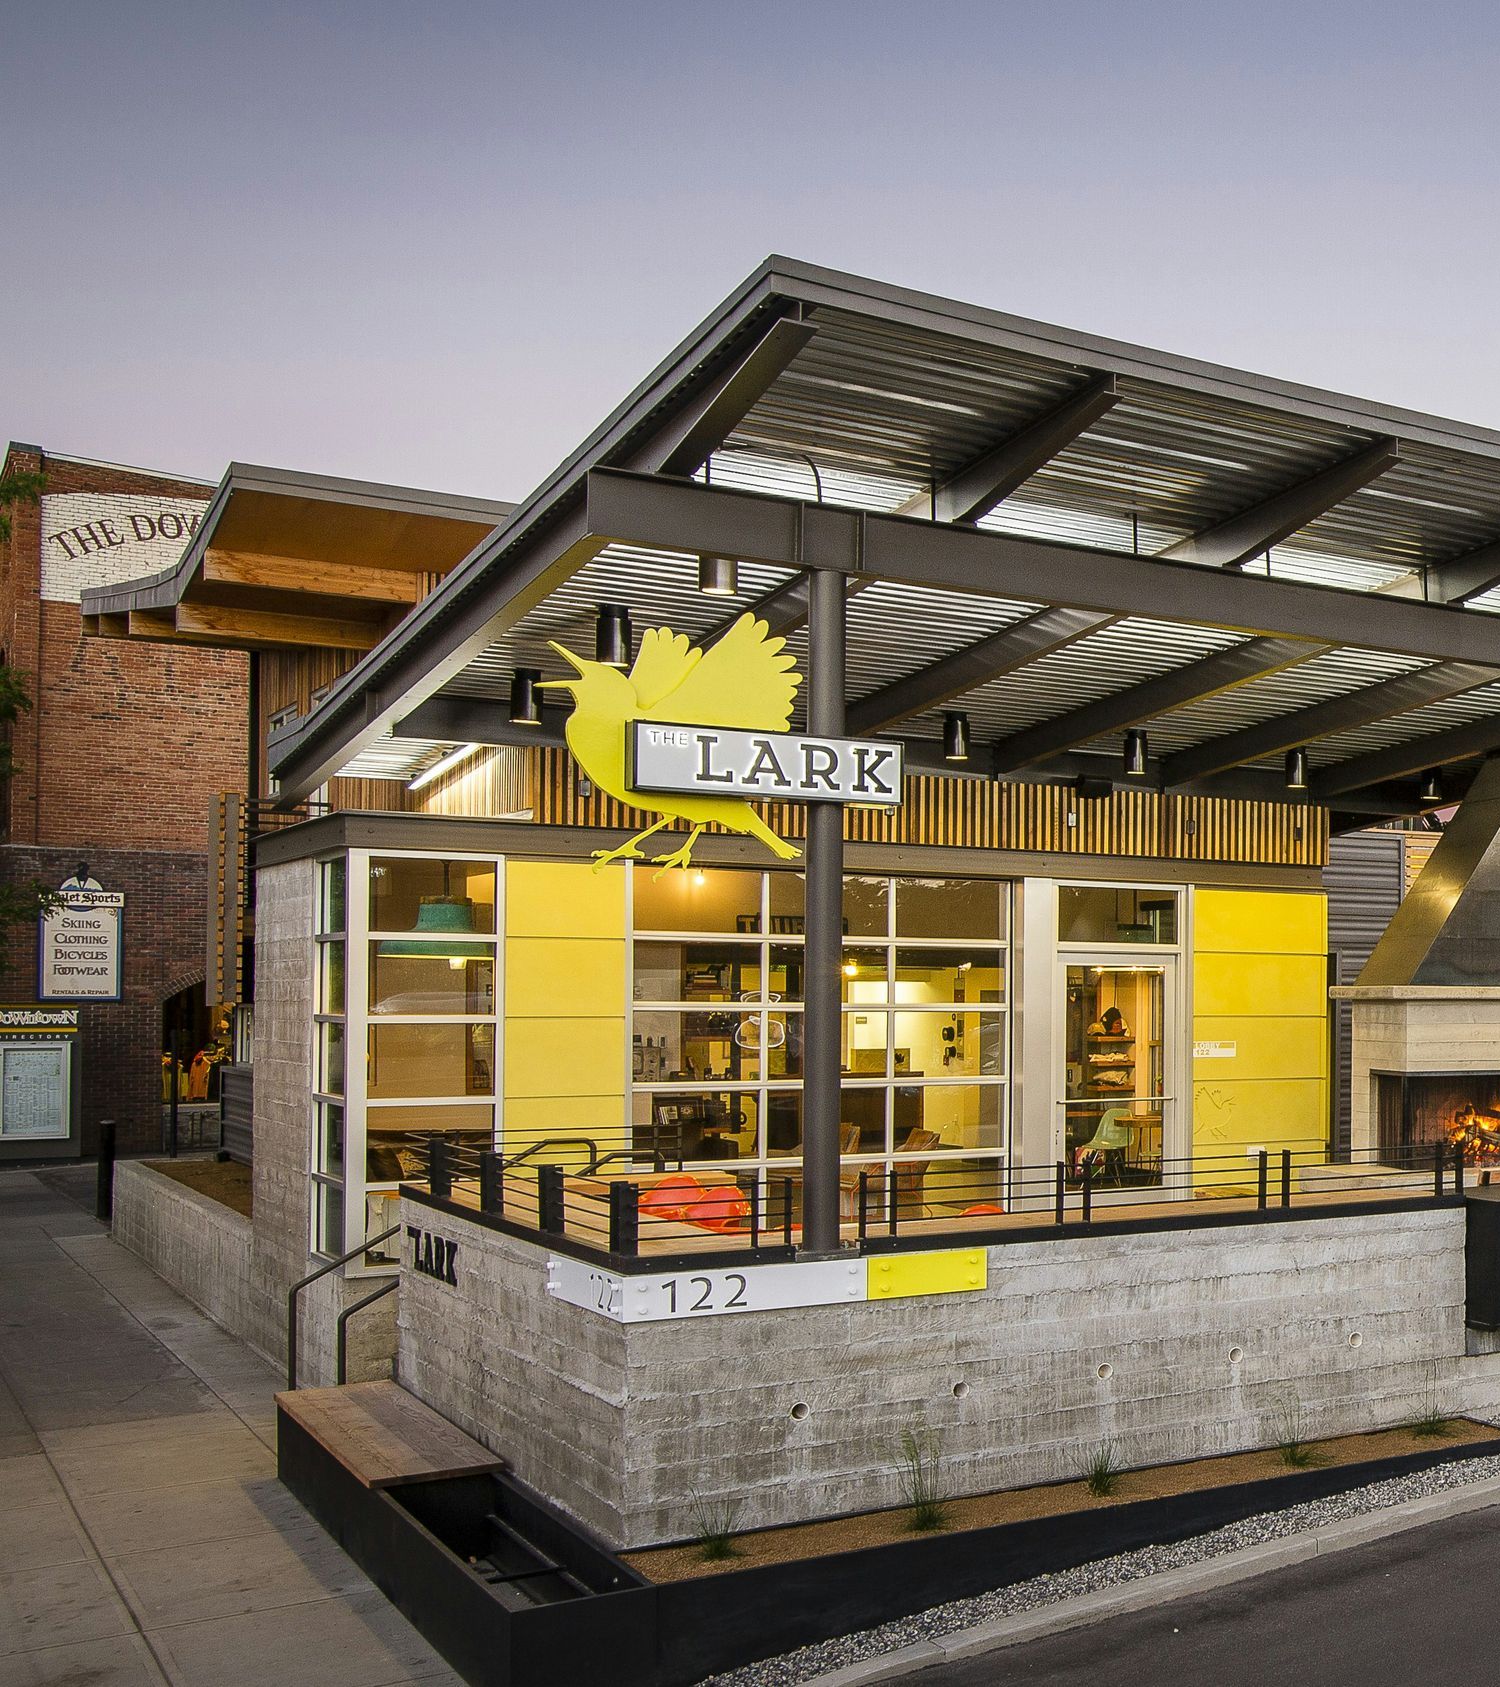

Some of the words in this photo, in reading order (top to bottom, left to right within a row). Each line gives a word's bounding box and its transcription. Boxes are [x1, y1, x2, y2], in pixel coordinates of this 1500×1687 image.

[48, 518, 125, 561] THE
[650, 730, 689, 746] THE
[696, 735, 893, 794] LARK
[81, 892, 121, 904] Sports
[61, 917, 102, 929] SKIING
[54, 933, 109, 945] CLOTHING
[54, 948, 108, 960] BICYCLES
[53, 964, 109, 976] FOOTWEAR
[661, 1273, 748, 1314] 122
